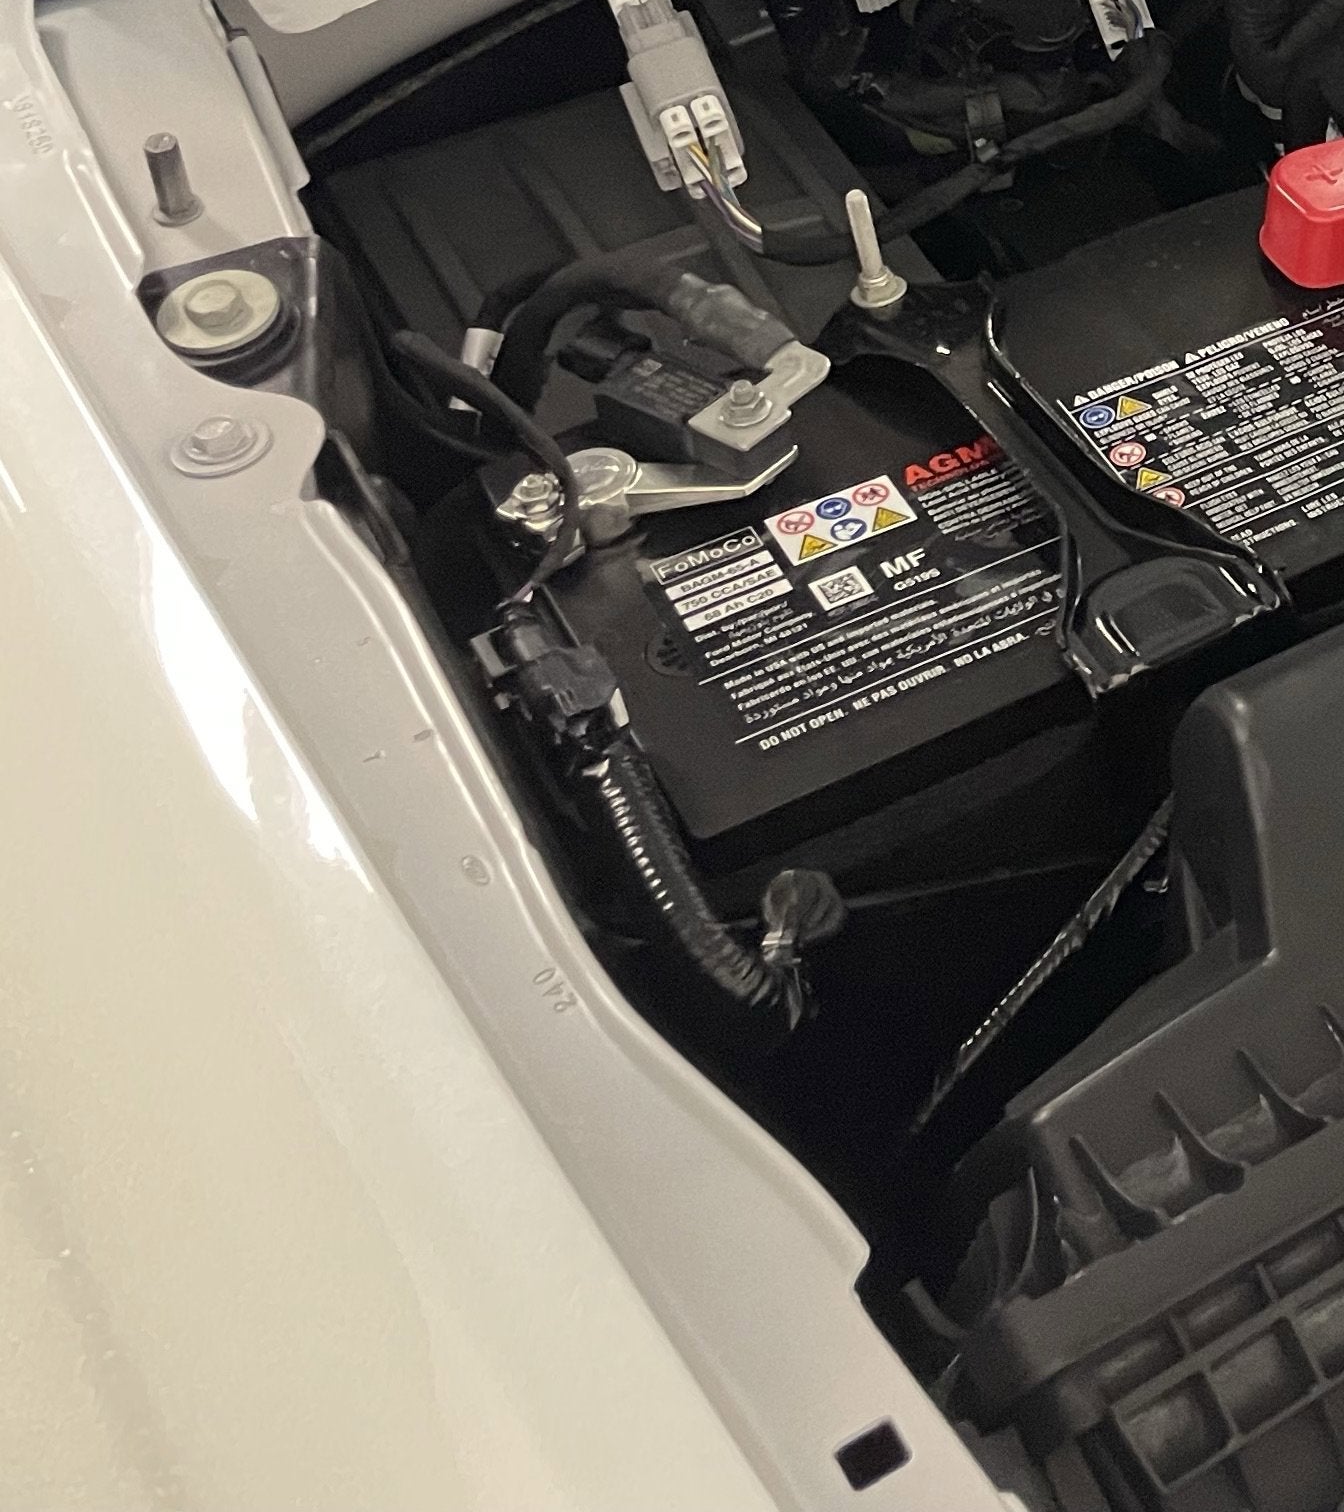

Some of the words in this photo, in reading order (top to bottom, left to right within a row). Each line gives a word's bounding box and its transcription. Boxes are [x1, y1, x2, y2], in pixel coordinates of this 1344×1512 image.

[1197, 317, 1290, 357] PELIGRO/VENENO
[1087, 360, 1179, 399] DANGER/POISON
[657, 535, 755, 578] FoMoCo
[879, 547, 925, 578] MF
[679, 558, 759, 592] BAGM-65-A
[681, 595, 708, 610] 750
[710, 569, 774, 599] CCA/SAE
[703, 609, 721, 621] 68
[724, 601, 744, 613] Ah
[746, 588, 774, 603] C20
[764, 659, 788, 672] USA
[953, 653, 973, 667] NO
[972, 646, 992, 659] LA
[851, 696, 871, 710] NE
[870, 685, 897, 702] PAS
[758, 735, 779, 750] DO
[779, 722, 807, 741] NOT
[808, 708, 848, 728] OPEN.
